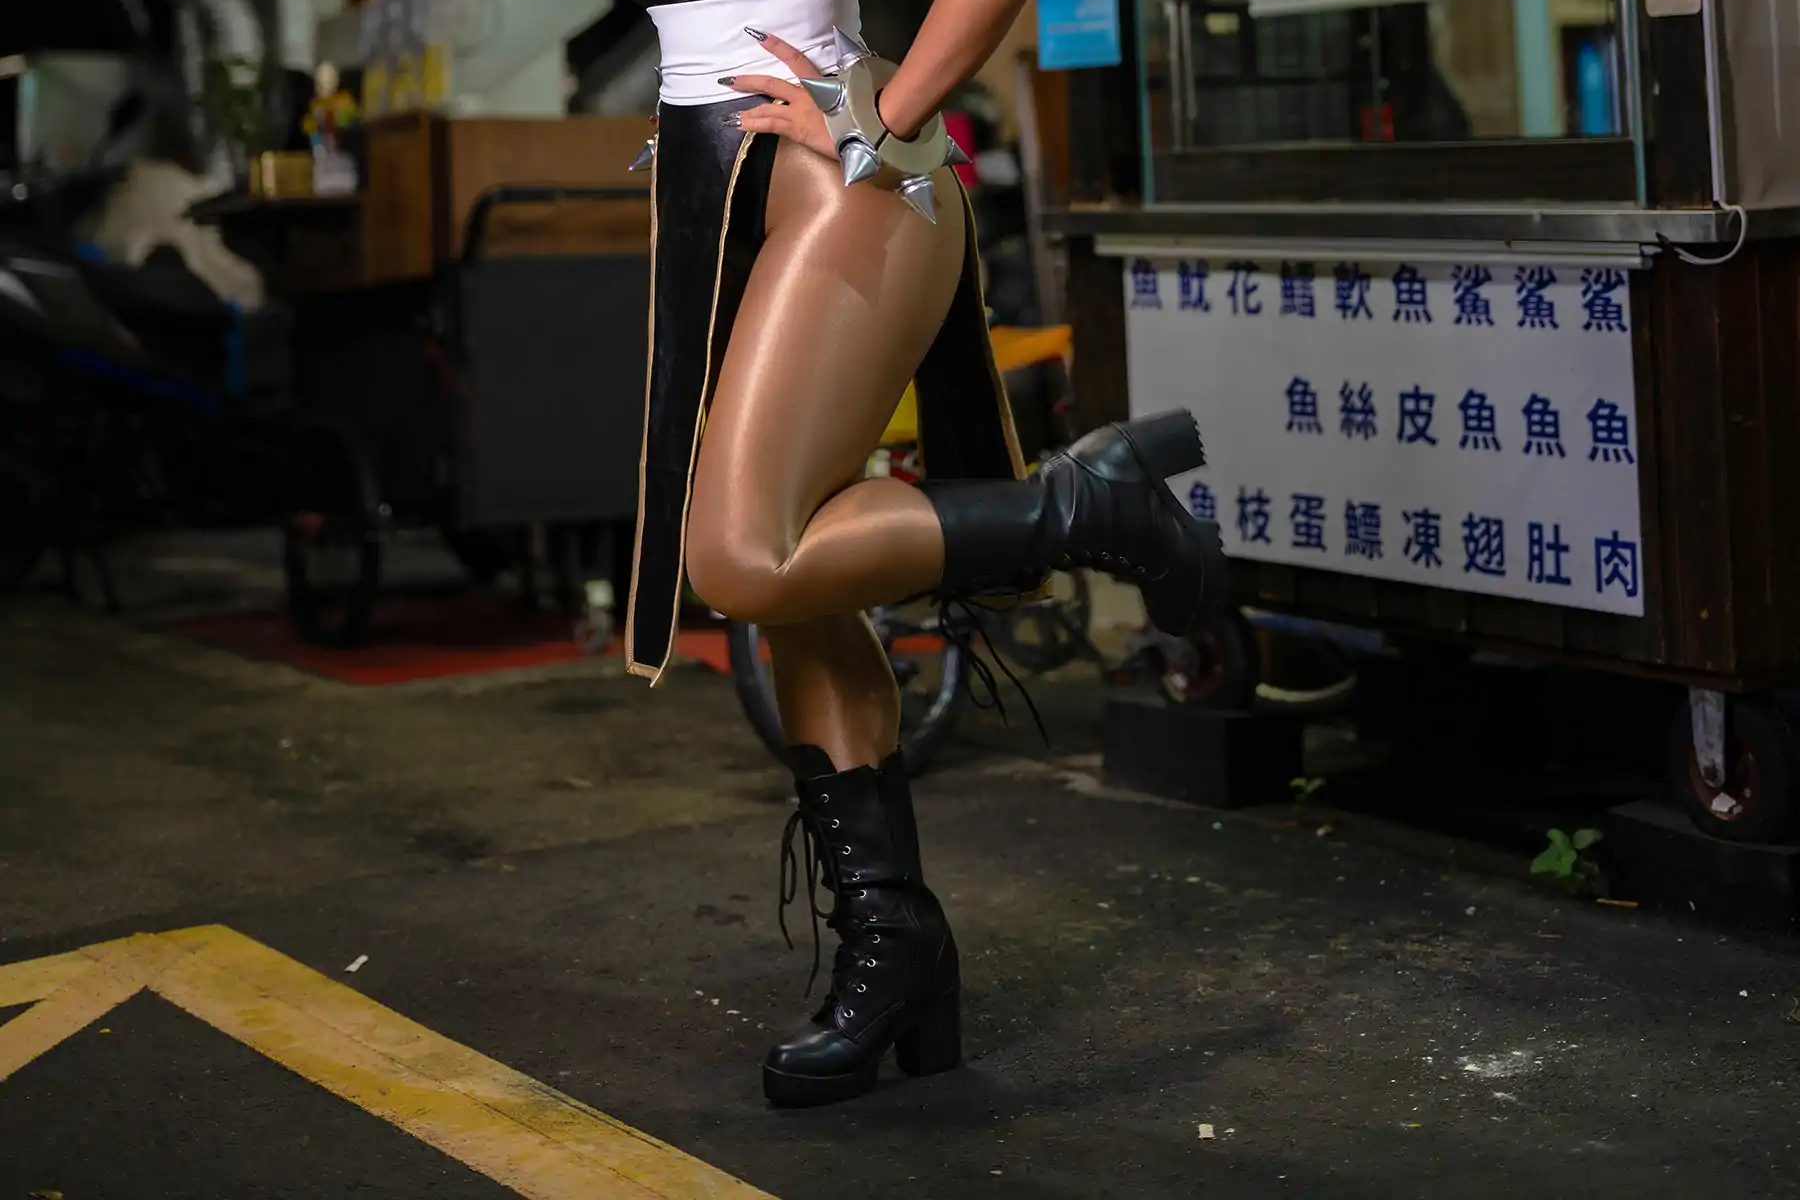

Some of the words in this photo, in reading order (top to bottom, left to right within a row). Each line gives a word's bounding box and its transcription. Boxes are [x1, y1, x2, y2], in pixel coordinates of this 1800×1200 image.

[1390, 261, 1443, 569] 魚皮凍
[1451, 263, 1507, 578] 鯊魚翅
[1513, 264, 1573, 587] 鯊魚肚
[1579, 266, 1639, 599] 鯊魚肉
